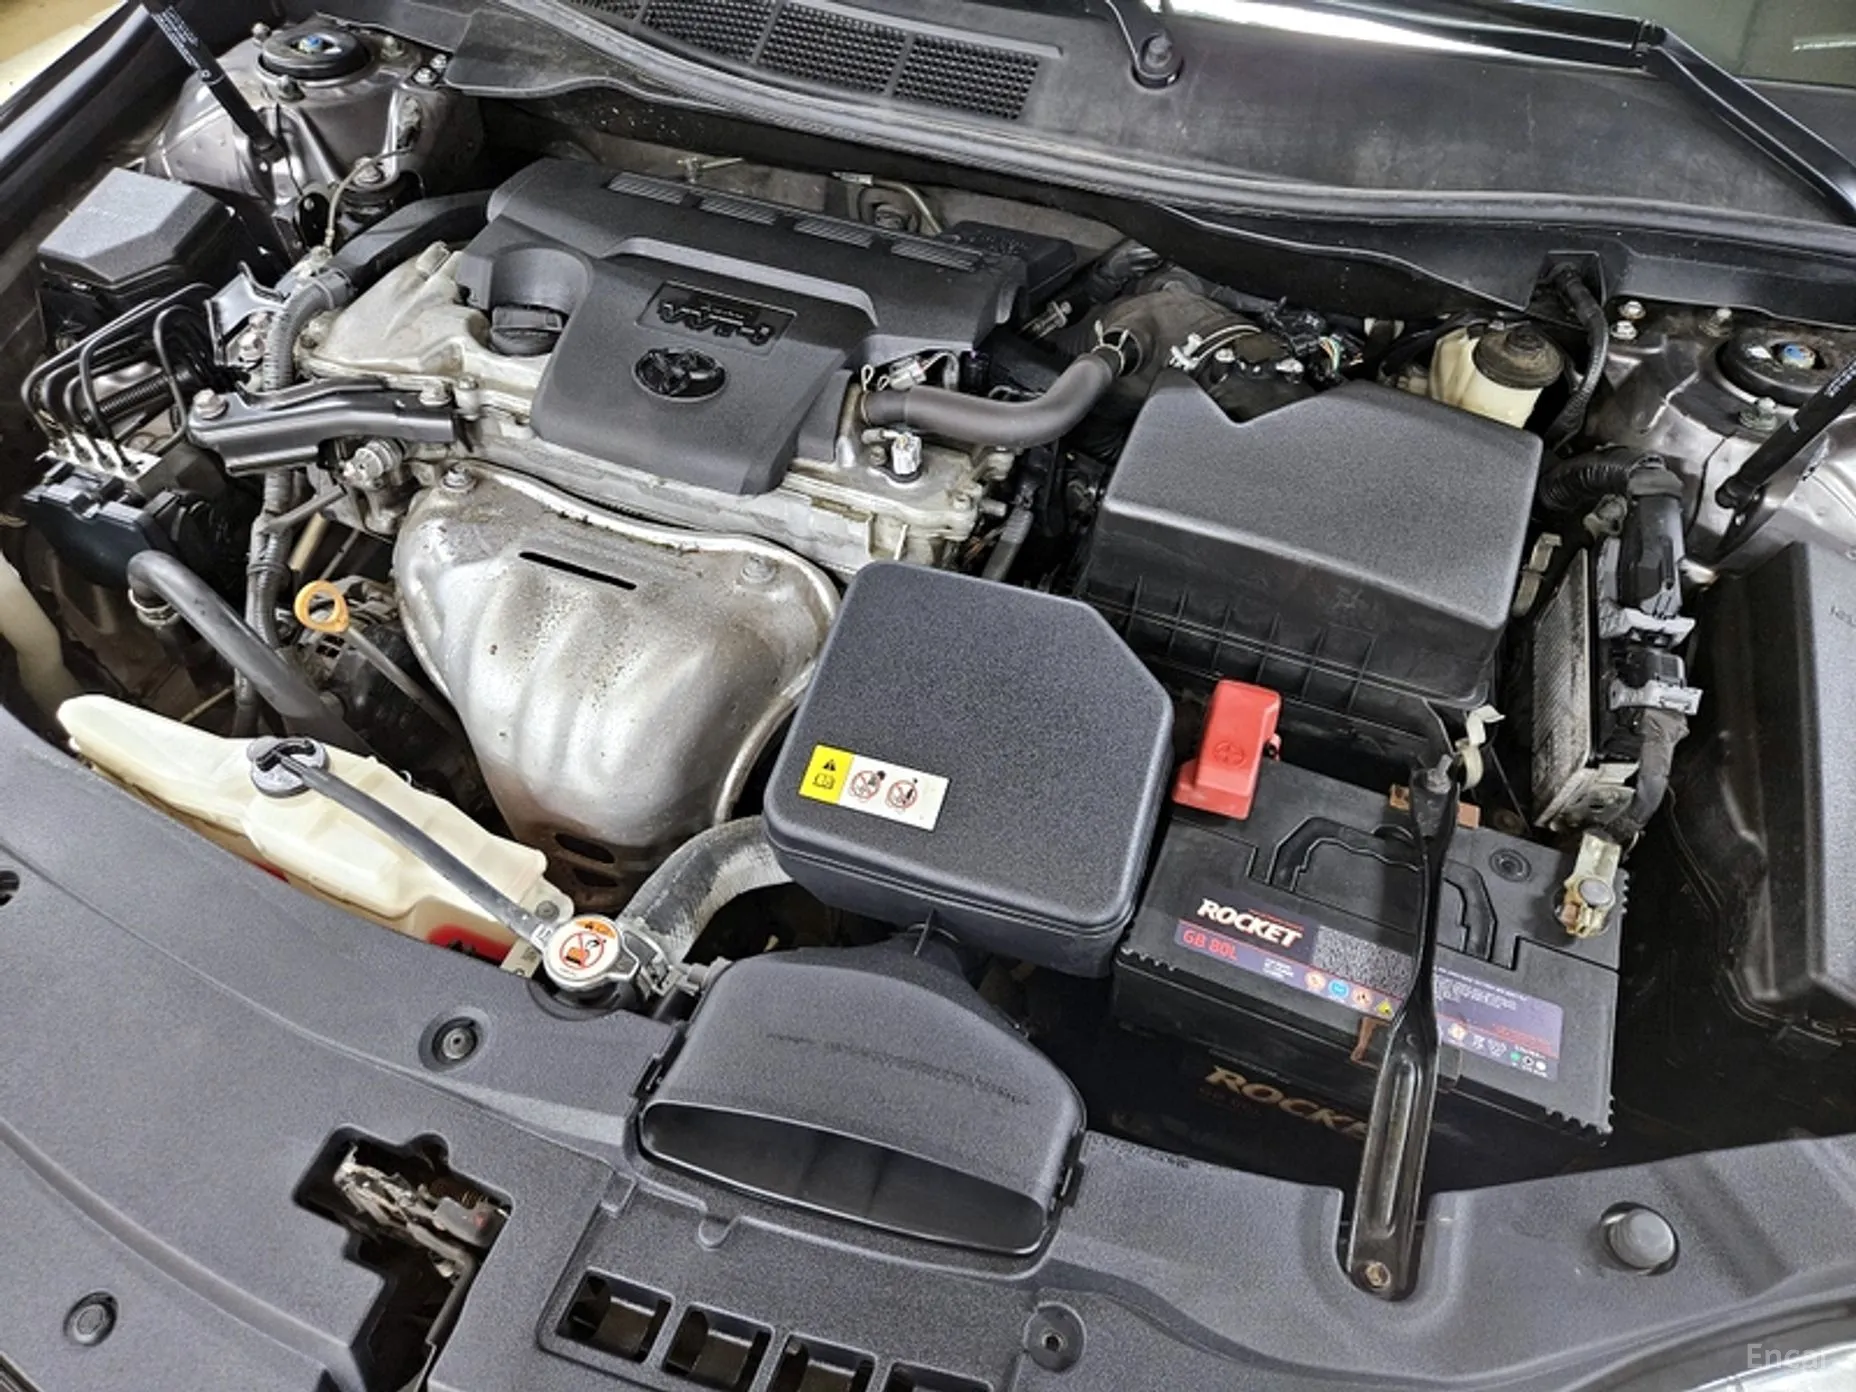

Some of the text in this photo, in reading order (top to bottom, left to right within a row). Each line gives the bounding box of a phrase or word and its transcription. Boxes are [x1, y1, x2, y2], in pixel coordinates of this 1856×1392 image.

[1197, 898, 1303, 948] ROCKET
[1183, 929, 1239, 961] GB 80L
